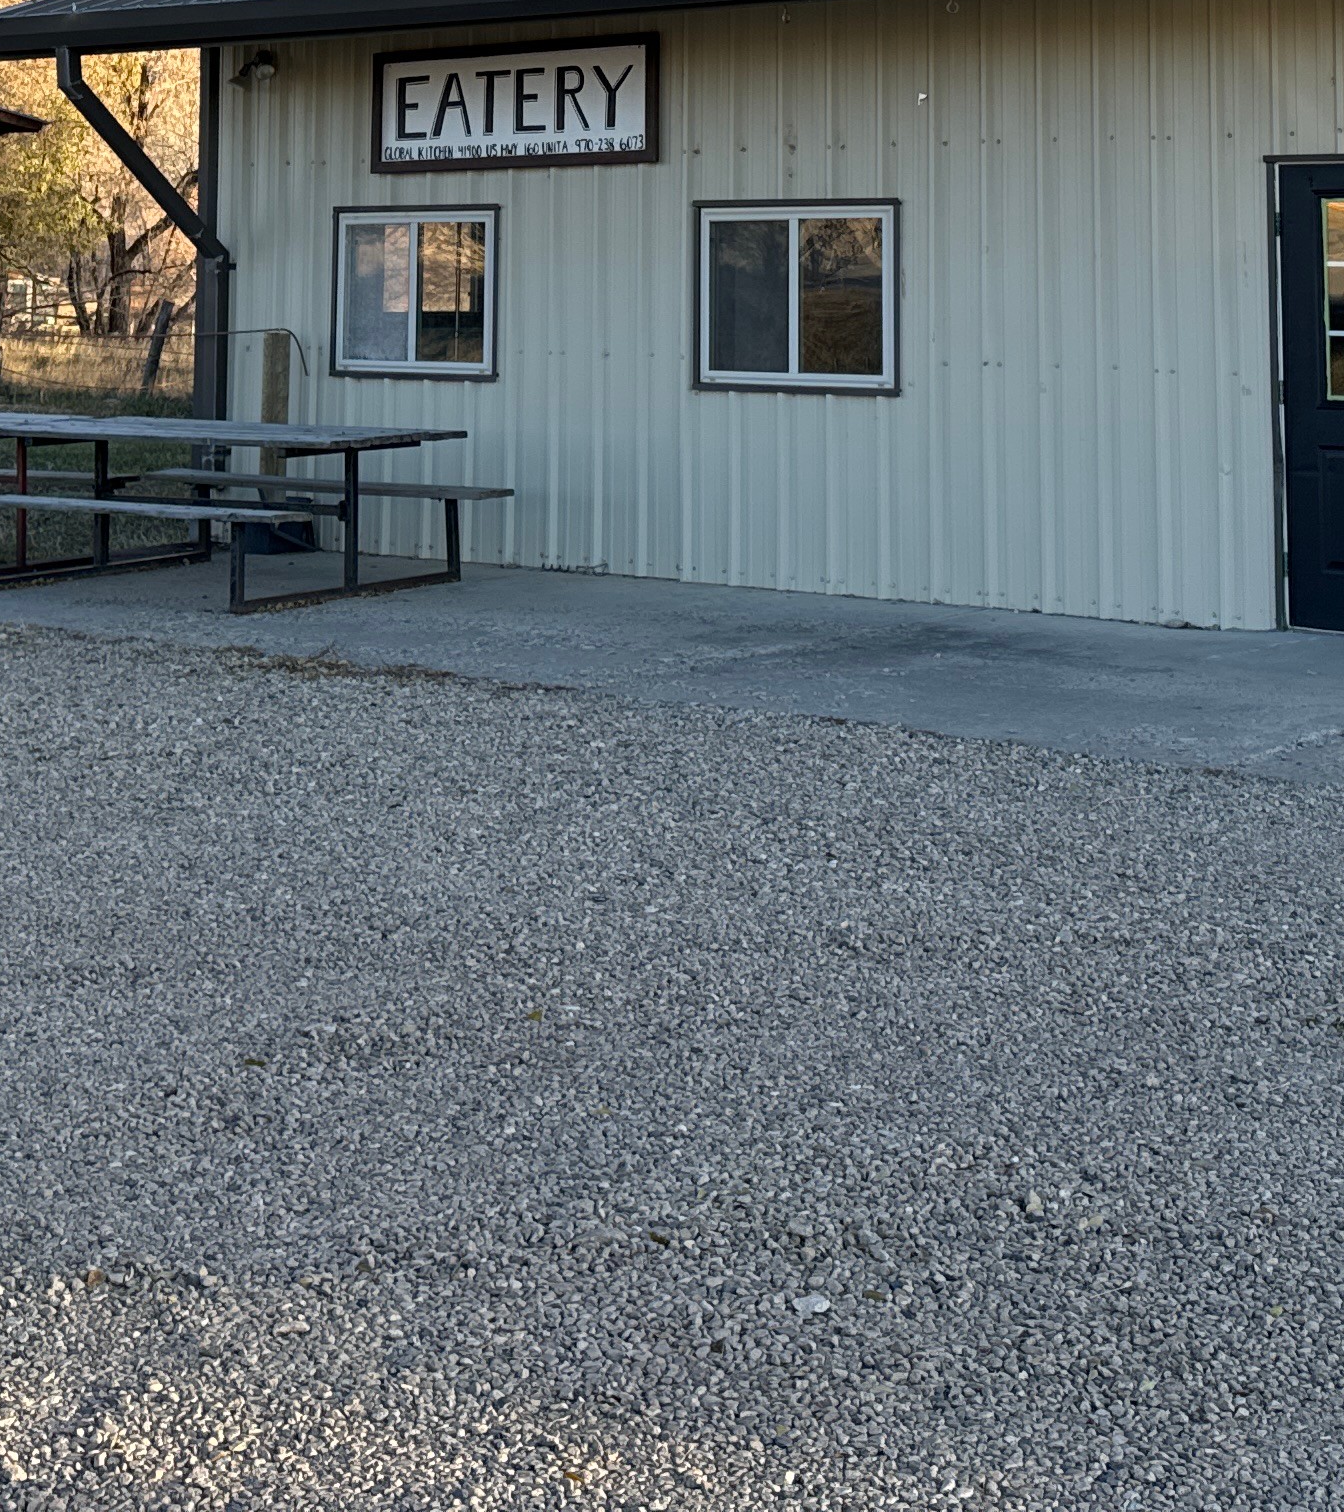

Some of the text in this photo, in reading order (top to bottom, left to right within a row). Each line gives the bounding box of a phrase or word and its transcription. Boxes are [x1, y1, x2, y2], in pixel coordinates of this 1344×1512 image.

[395, 64, 634, 141] EATERY
[384, 145, 414, 161] GLOBAL
[417, 145, 454, 160] KITCHEN
[486, 143, 498, 157] US
[500, 142, 518, 156] HWY
[524, 142, 540, 155] 160
